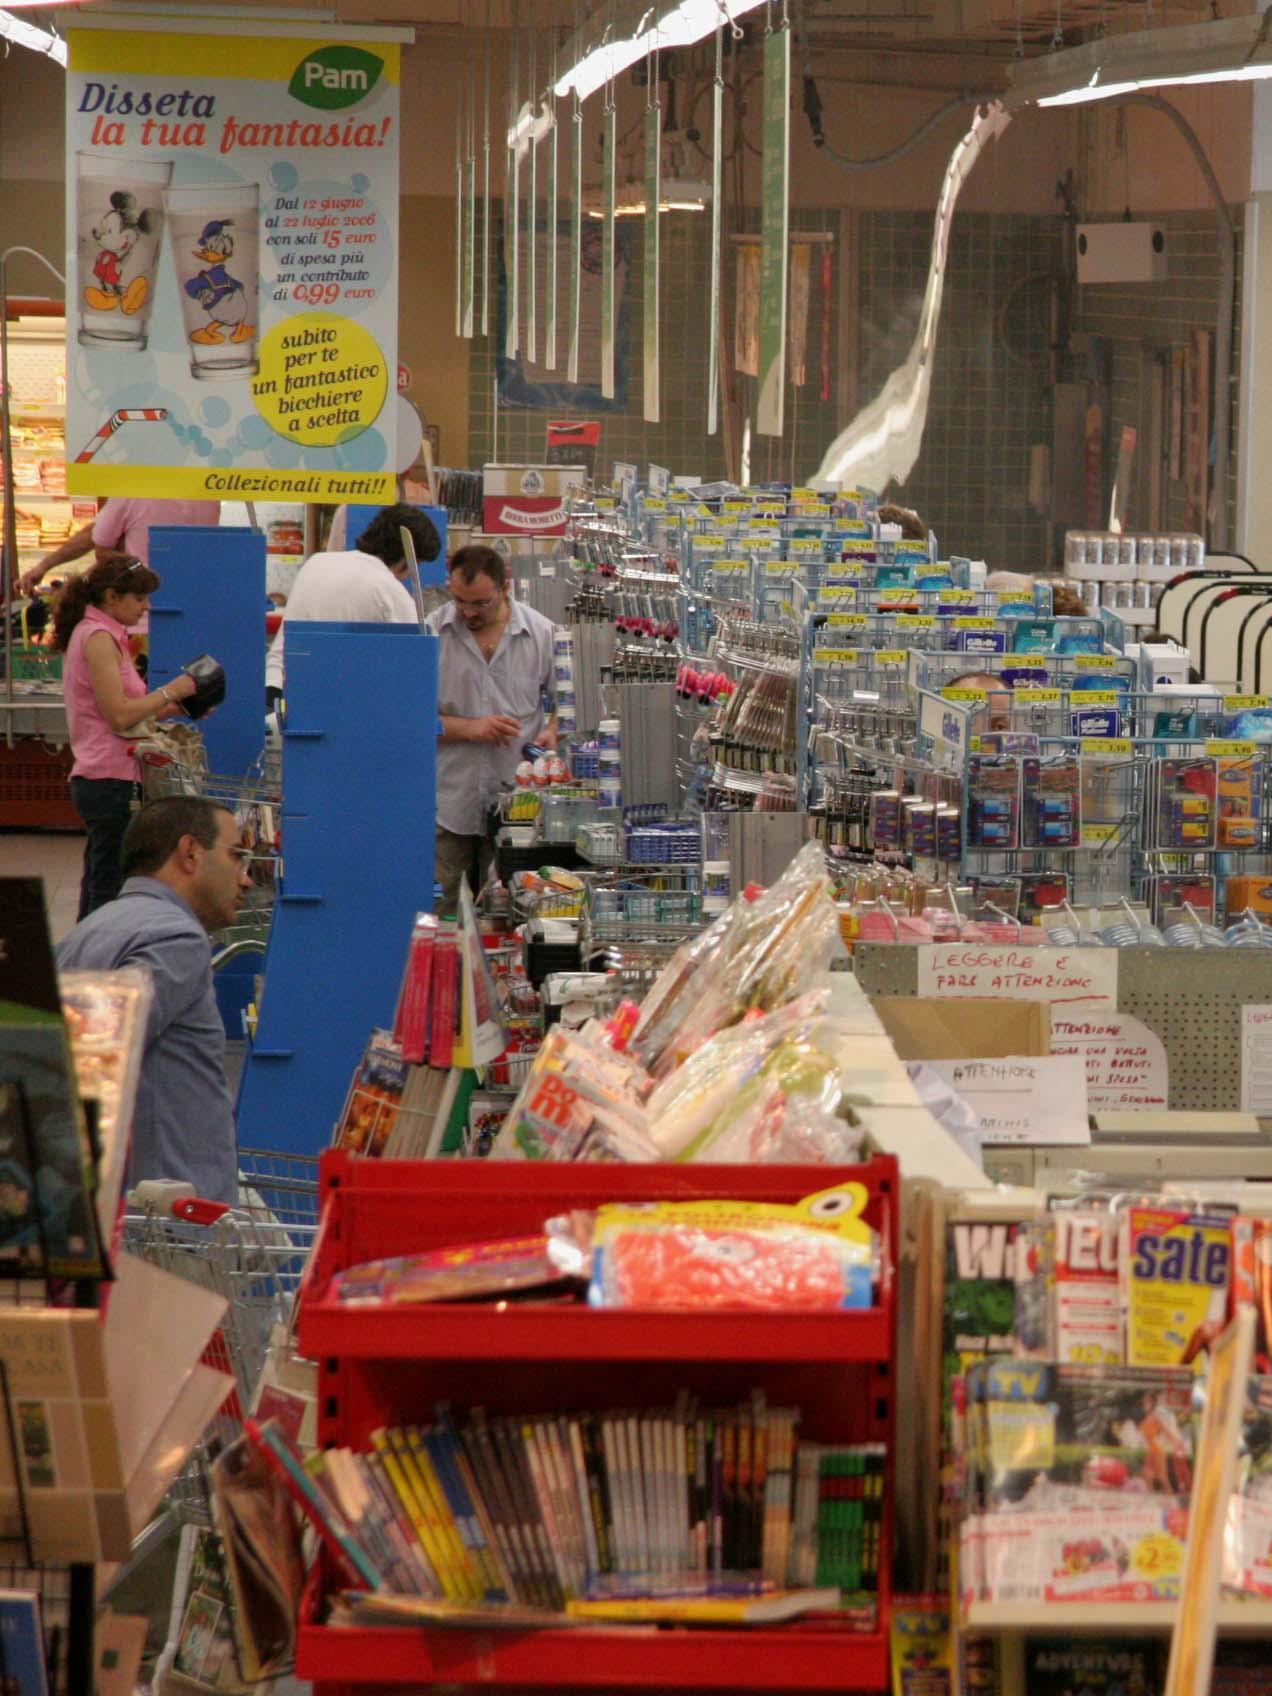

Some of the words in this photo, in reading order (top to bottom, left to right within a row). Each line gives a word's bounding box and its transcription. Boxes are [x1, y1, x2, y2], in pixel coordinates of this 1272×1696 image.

[304, 63, 368, 90] Pam
[78, 82, 216, 118] Disseta
[91, 119, 125, 146] la
[142, 119, 206, 147] tua
[219, 116, 391, 154] fantasia!
[275, 197, 299, 210] Dal
[320, 197, 364, 211] giugno
[265, 216, 279, 228] al
[302, 216, 339, 229] luglio
[266, 235, 291, 246] con
[294, 232, 318, 246] soli
[322, 229, 342, 248] 15
[345, 232, 377, 244] euro
[280, 253, 295, 265] di
[298, 254, 336, 267] spesa
[277, 273, 295, 283] un
[300, 269, 370, 282] contributo
[273, 289, 287, 301] di
[344, 287, 376, 299] euro
[280, 327, 337, 350] subito
[284, 350, 318, 372] per
[321, 347, 339, 363] te
[252, 380, 278, 396] un
[284, 364, 379, 394] fantastico
[278, 389, 363, 415] bicchiere
[288, 418, 300, 432] a
[306, 408, 360, 430] scelta
[204, 473, 322, 494] Collezionali
[327, 477, 387, 496] tutti!!
[932, 952, 1034, 971] LEGGERE
[991, 972, 1092, 989] ATTENZIONE
[1050, 1022, 1121, 1036] TTENZIONE
[996, 1371, 1042, 1397] TV
